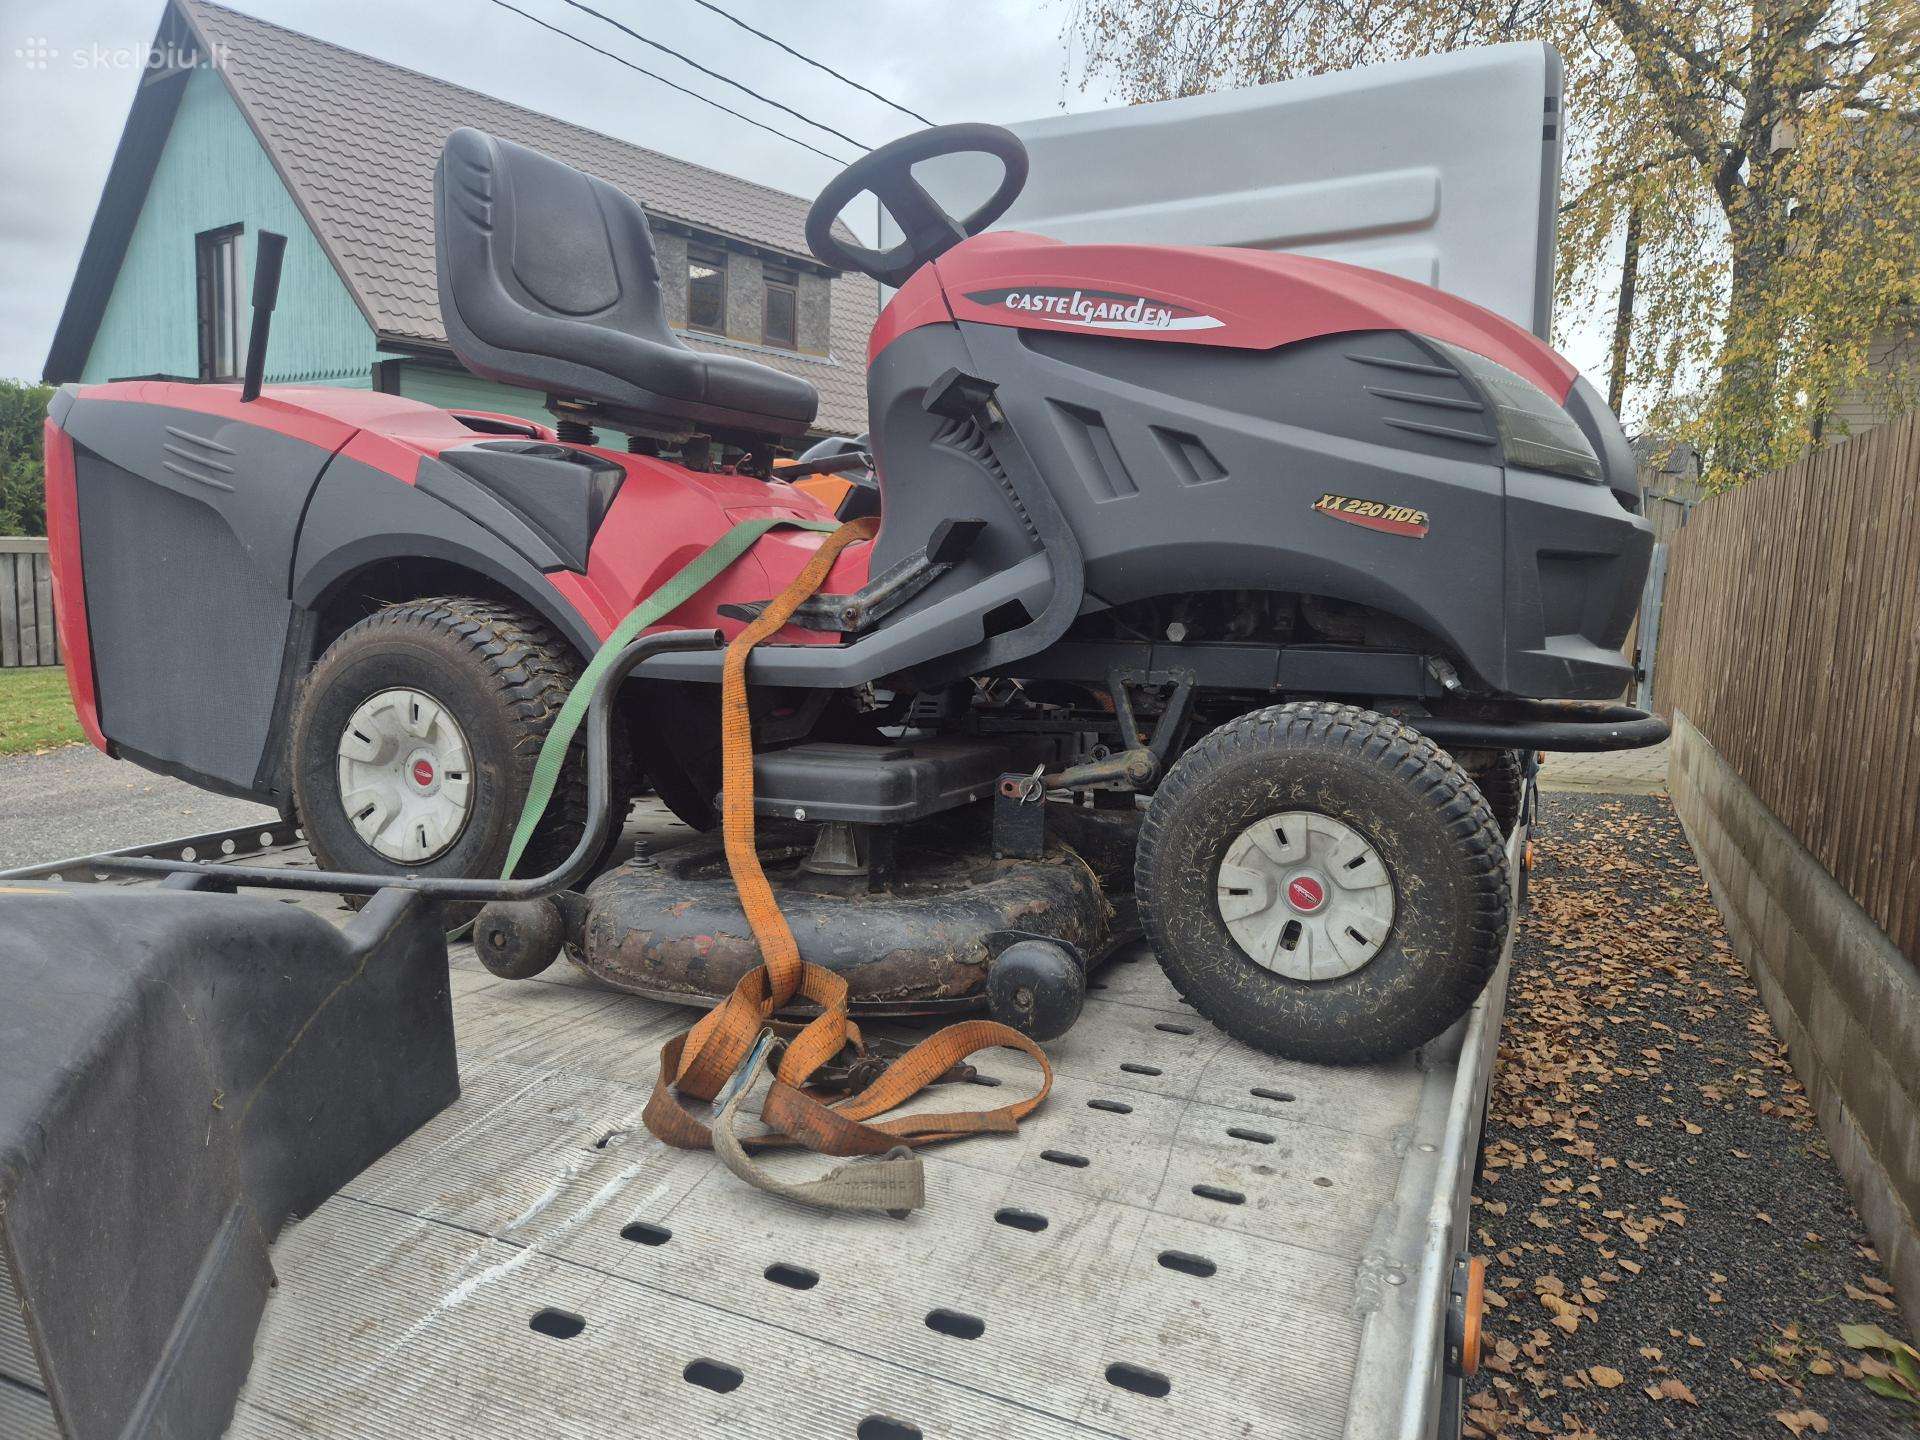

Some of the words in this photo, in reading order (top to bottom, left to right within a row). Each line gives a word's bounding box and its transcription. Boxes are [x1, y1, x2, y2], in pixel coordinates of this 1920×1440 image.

[1316, 494, 1346, 510] XX
[1345, 499, 1384, 517] 220
[1382, 505, 1426, 525] HDE
